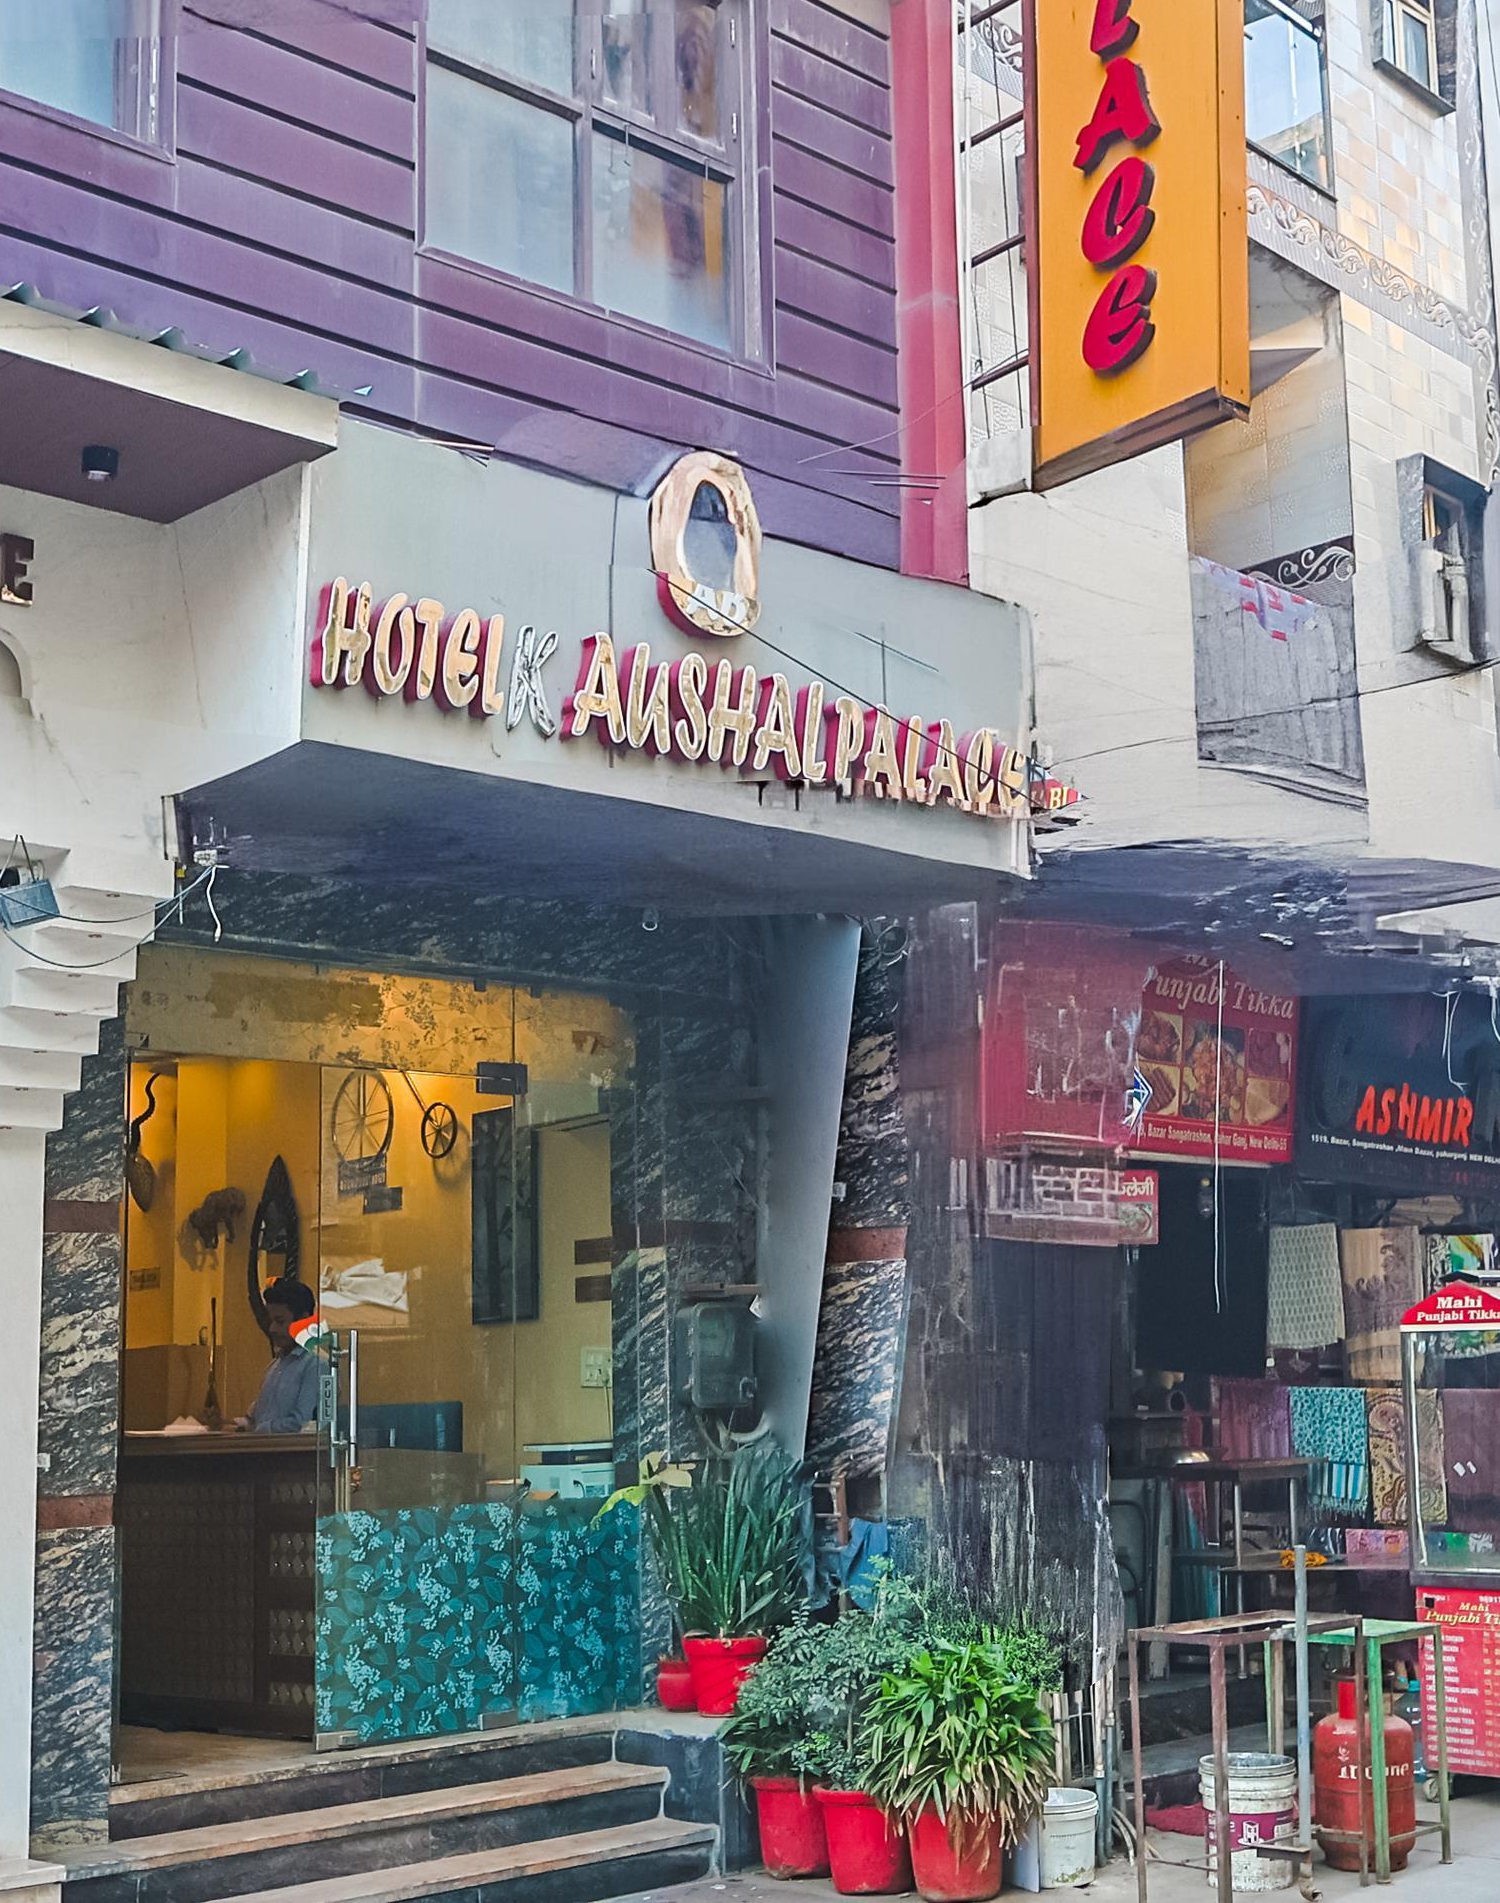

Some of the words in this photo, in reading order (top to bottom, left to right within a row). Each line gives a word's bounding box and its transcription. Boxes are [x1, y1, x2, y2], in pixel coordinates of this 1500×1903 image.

[311, 577, 505, 717] HOTEL
[1436, 1295, 1483, 1309] Mahi
[1416, 1310, 1464, 1324] Punjabi
[1459, 1602, 1490, 1612] Mahi
[1425, 1610, 1481, 1626] Punjabi
